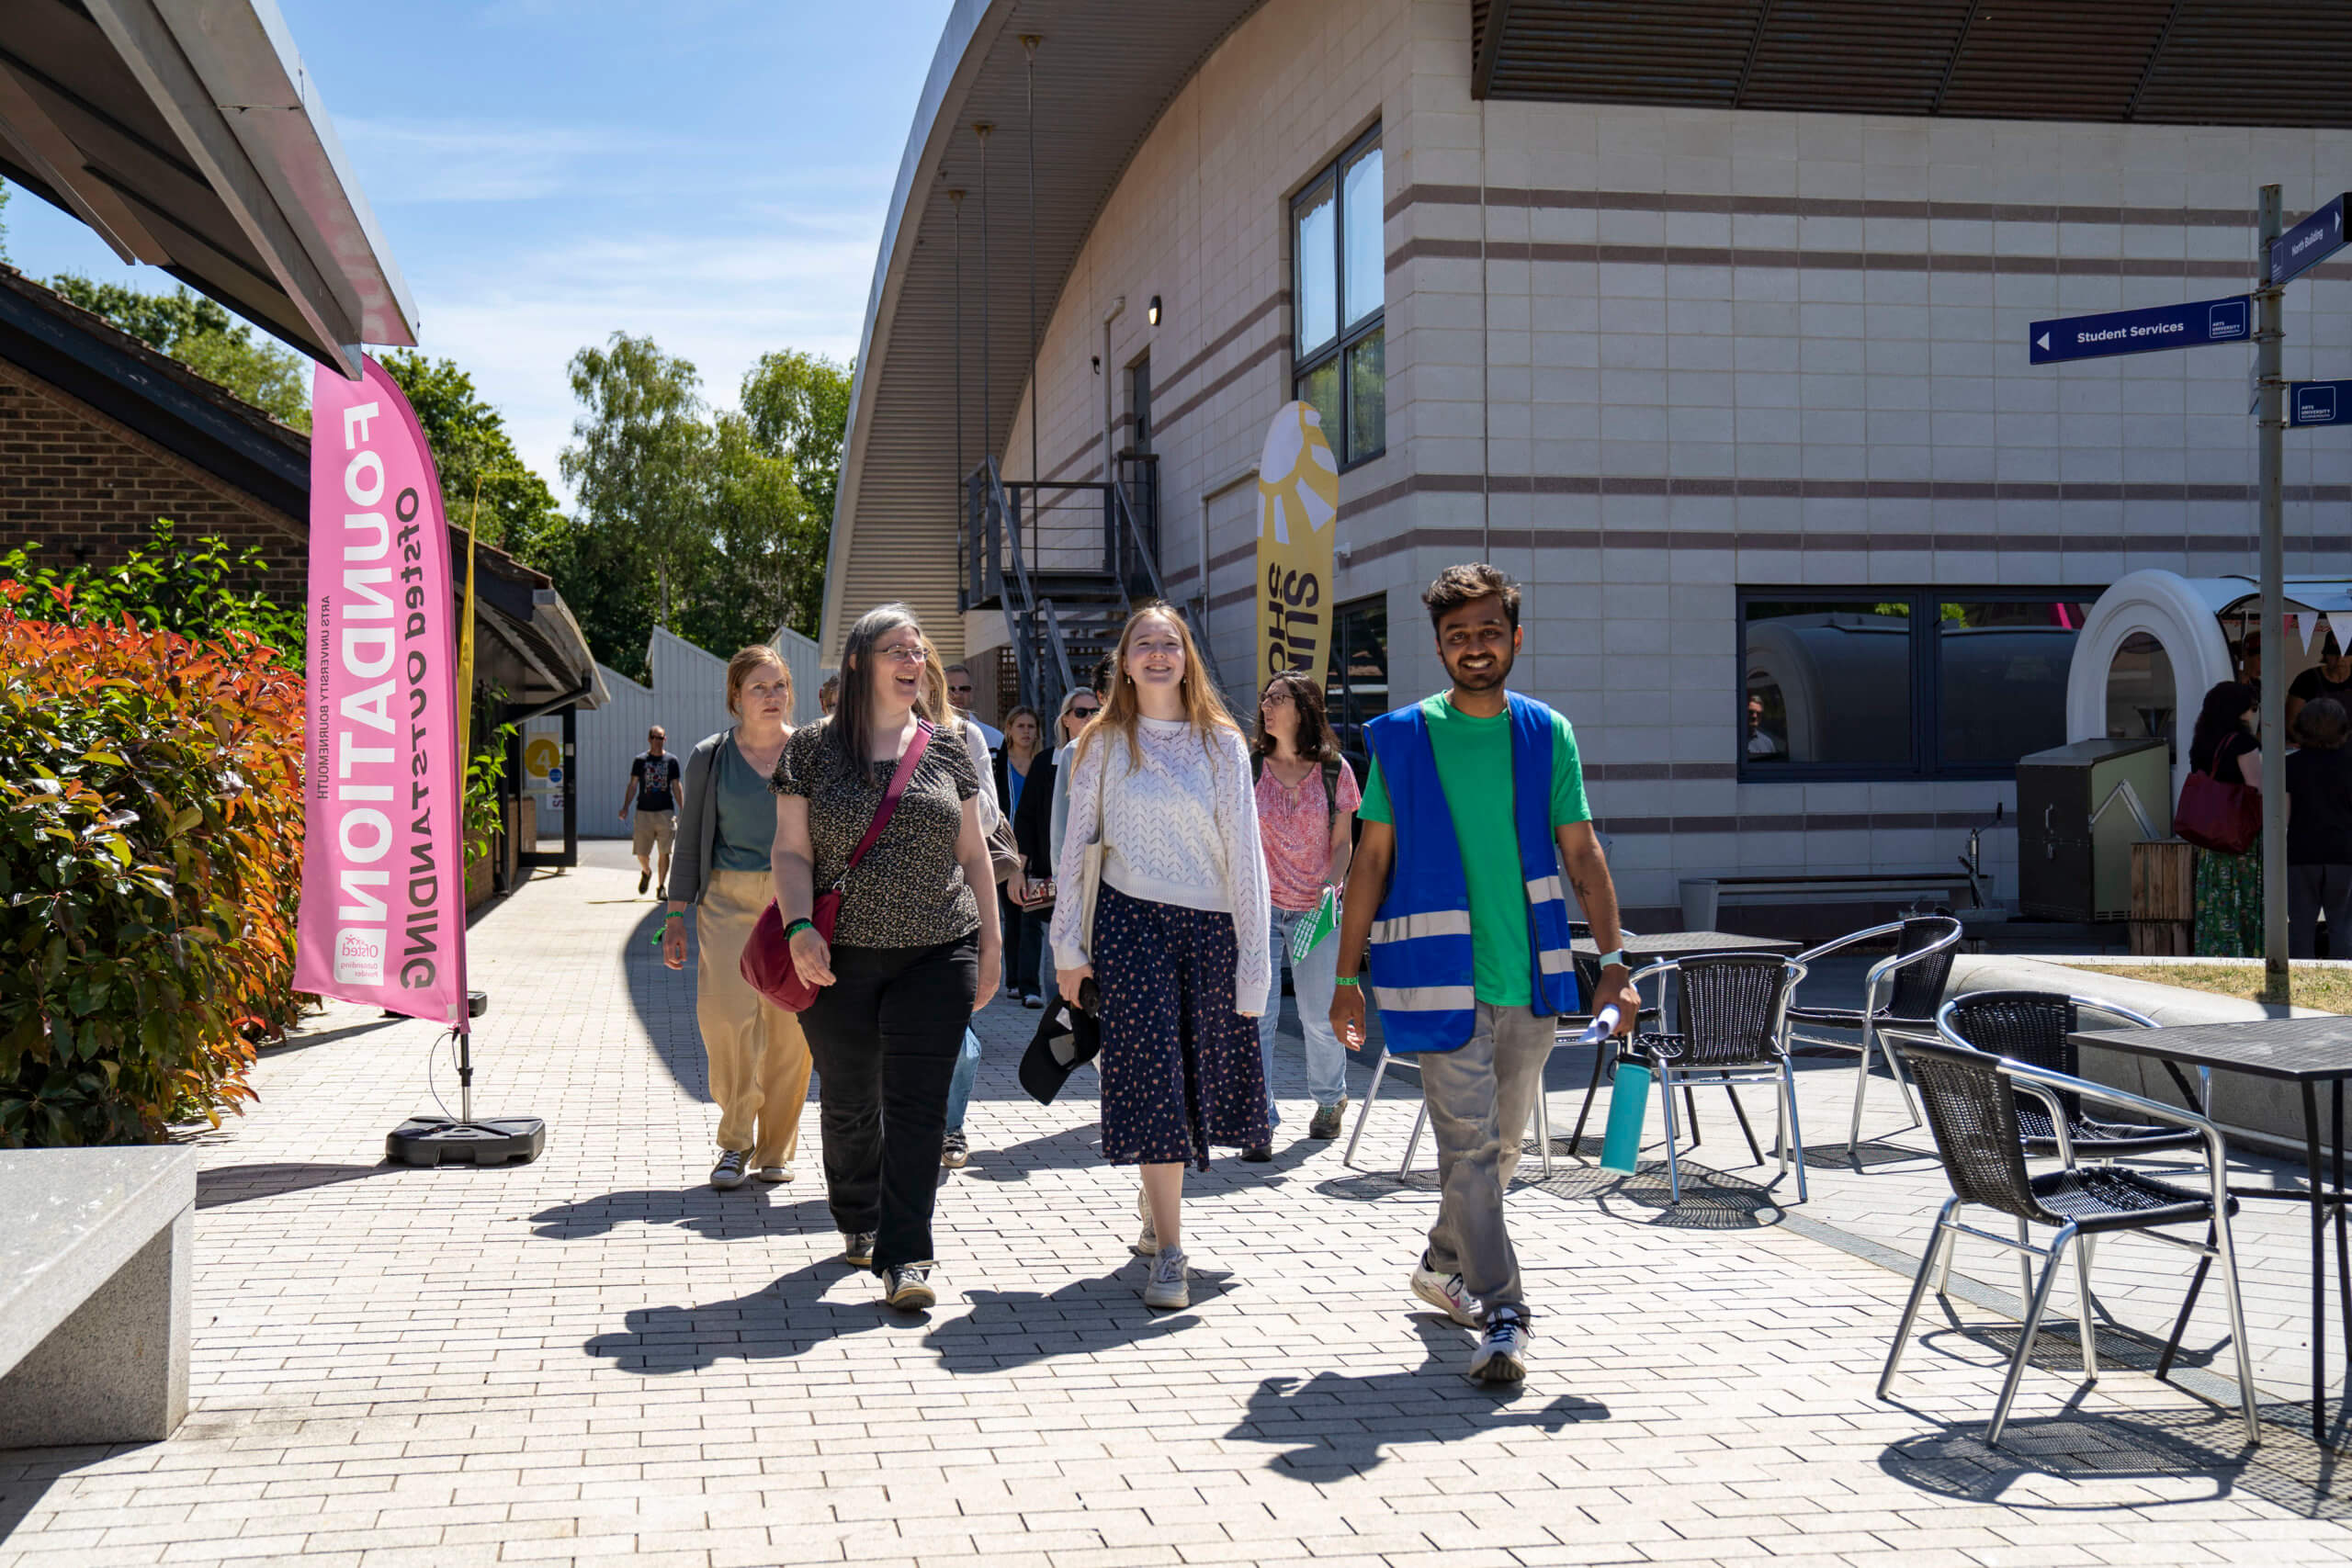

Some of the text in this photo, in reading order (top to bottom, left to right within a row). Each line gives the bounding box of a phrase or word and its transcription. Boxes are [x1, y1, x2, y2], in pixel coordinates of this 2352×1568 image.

[2077, 322, 2185, 344] Student Services
[537, 749, 550, 770] 4
